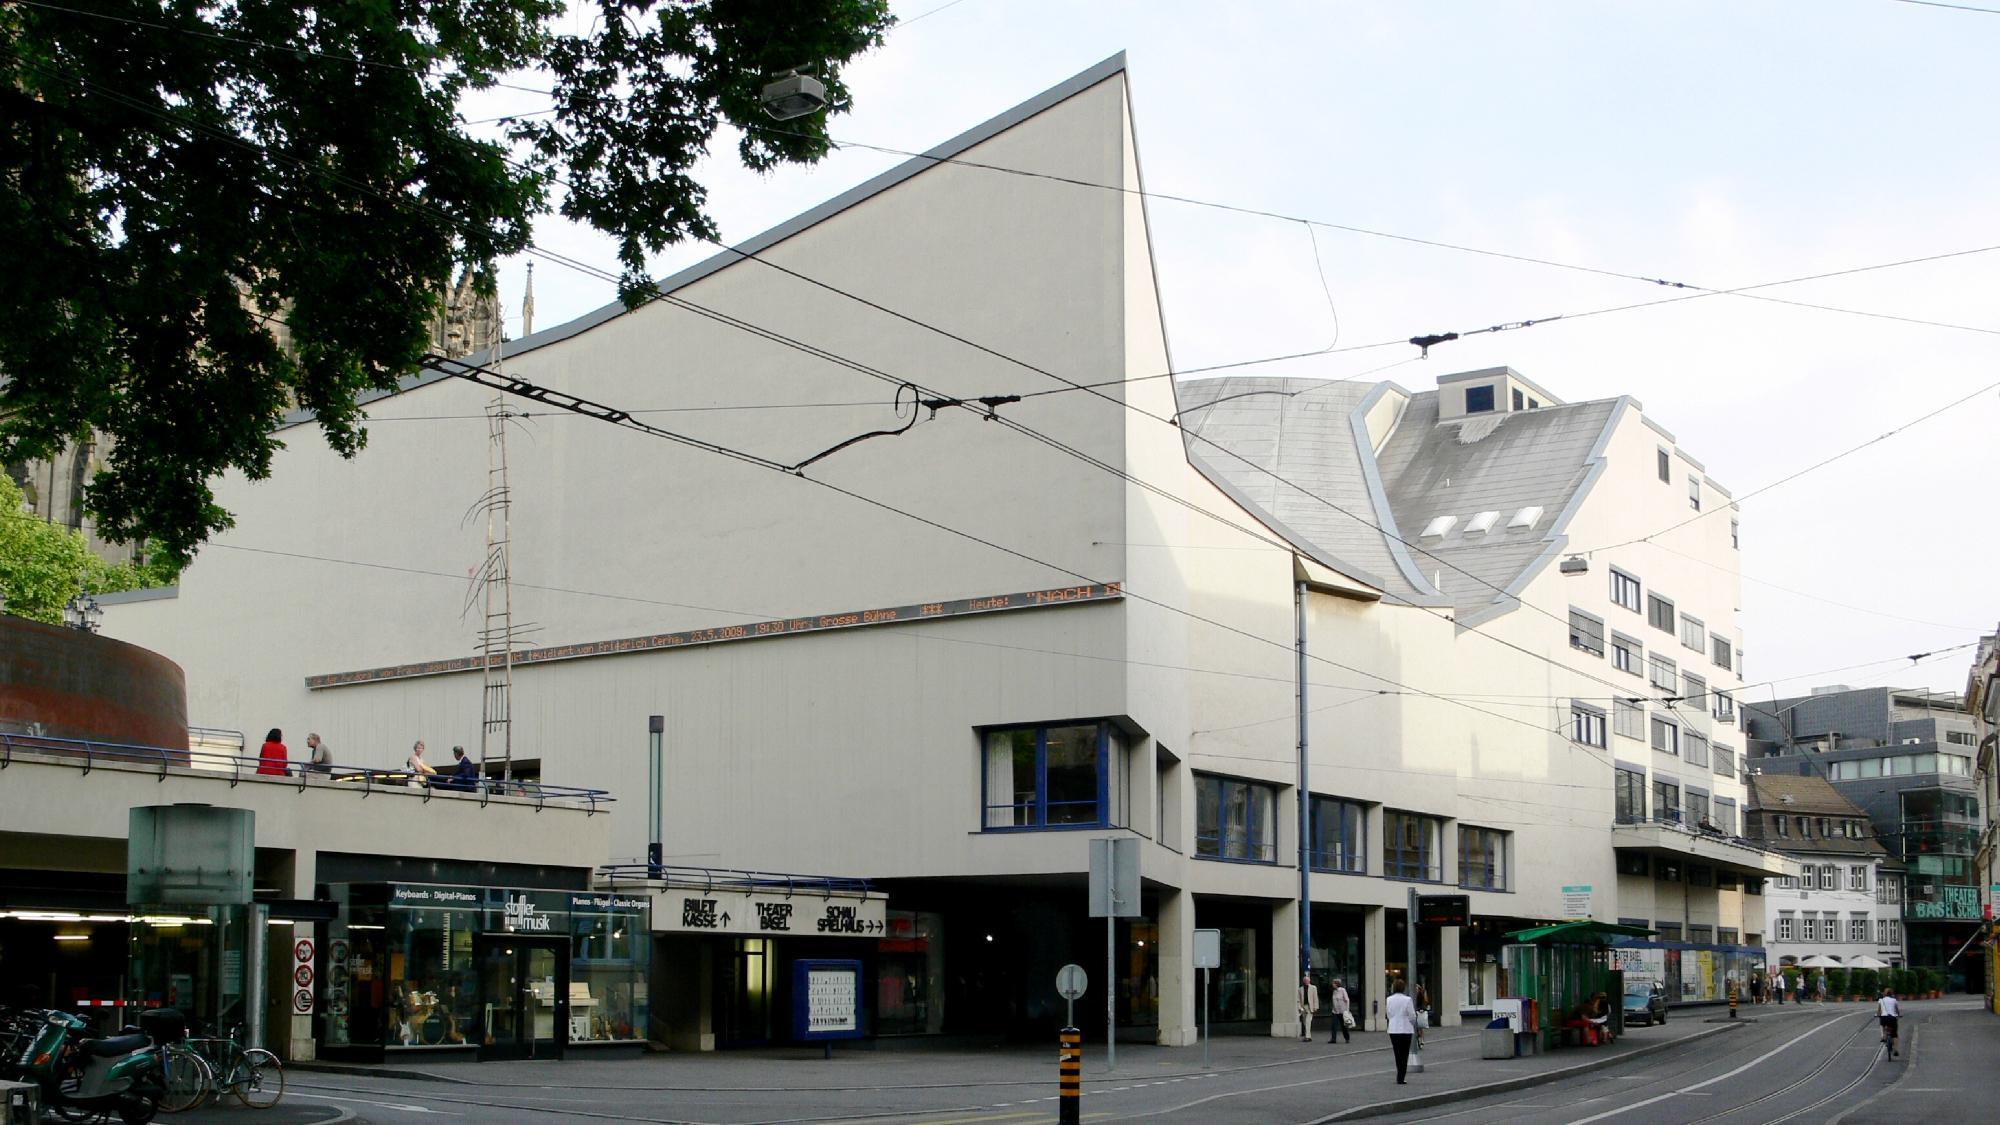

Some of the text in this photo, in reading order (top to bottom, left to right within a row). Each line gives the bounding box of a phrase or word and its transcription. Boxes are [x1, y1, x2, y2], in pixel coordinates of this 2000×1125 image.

[755, 621, 784, 635] 19:30
[820, 615, 858, 627] Grosse
[863, 609, 897, 622] Bühne
[396, 889, 476, 902] Keyboards Digital-Pianos
[572, 896, 650, 909] Pianos Flügel Classic Organs
[1944, 887, 1978, 903] THEATER
[755, 902, 793, 917] THEATER
[826, 905, 857, 919] SCHAU
[1916, 902, 1955, 918] BASEL
[522, 914, 550, 931] musik
[682, 912, 718, 929] KASSE
[760, 916, 791, 931] BASEL
[817, 918, 865, 934] SPIELHAUS
[1494, 1011, 1517, 1020] NEWS
